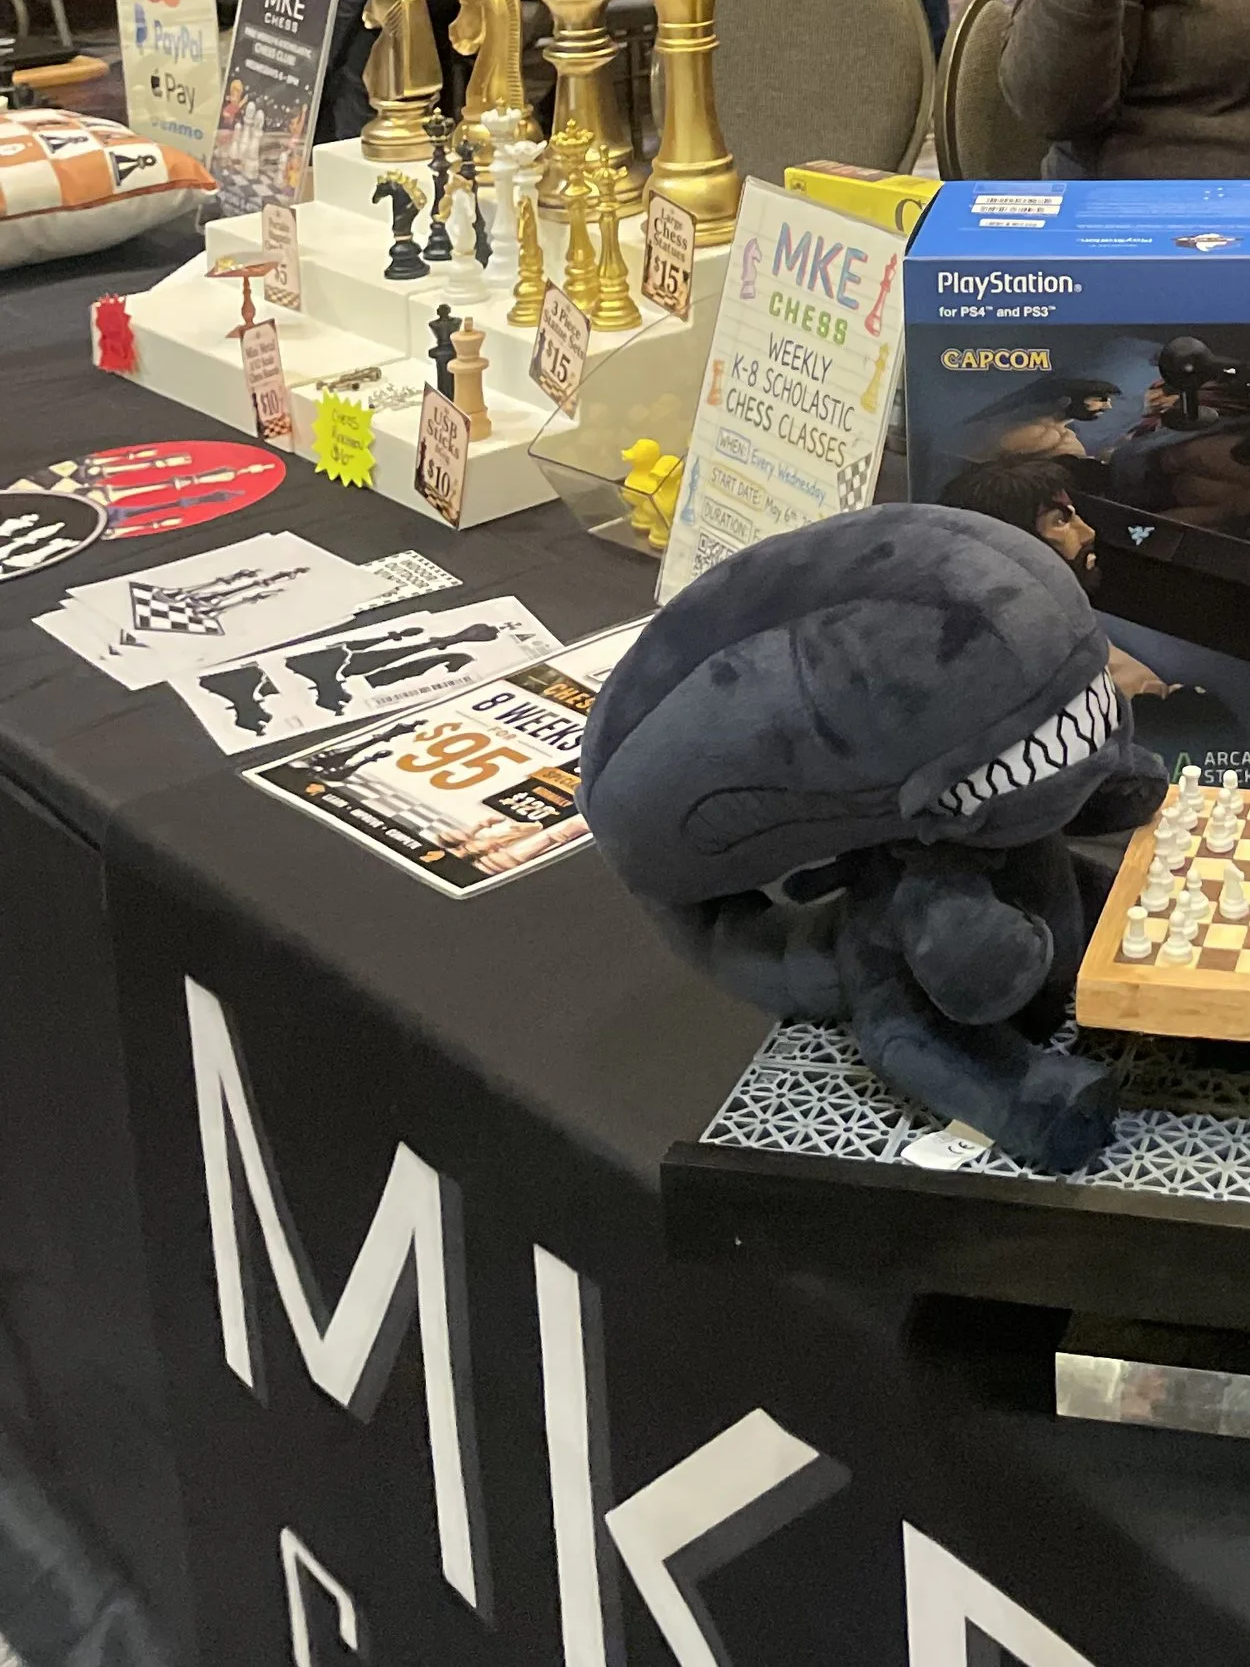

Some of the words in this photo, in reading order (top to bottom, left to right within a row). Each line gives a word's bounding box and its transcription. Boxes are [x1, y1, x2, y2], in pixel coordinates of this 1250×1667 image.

[153, 19, 203, 64] PayPal
[264, 12, 298, 34] CHESS
[165, 72, 196, 115] Pay
[654, 217, 688, 251] Chess
[661, 207, 683, 231] Large
[653, 232, 686, 264] Statues
[771, 221, 869, 311] MKE
[653, 255, 679, 295] $15
[938, 271, 1074, 300] PlayStation
[551, 301, 559, 316] 3
[560, 308, 581, 340] Piece
[769, 291, 848, 346] CHESS
[939, 306, 957, 317] for
[996, 306, 1020, 317] and
[547, 339, 571, 383] $15
[768, 332, 833, 384] WEEKLY
[941, 348, 1052, 371] CAPCOM
[260, 389, 279, 415] $10
[731, 352, 759, 388] K-8
[762, 368, 856, 432] SCHOLASTIC
[427, 418, 459, 460] Sticks
[434, 406, 458, 439] USB
[726, 387, 774, 431] CHESS
[778, 414, 847, 468] CLASSES
[428, 459, 450, 498] $10
[720, 434, 747, 456] WHEN:
[751, 448, 775, 480] Every
[778, 462, 826, 507] Wednesday
[711, 467, 735, 488] START
[737, 484, 761, 505] DATE:
[765, 497, 782, 524] May
[543, 683, 596, 712] CHES
[472, 692, 516, 712] 8
[494, 701, 584, 752] WEEKS
[488, 726, 517, 742] FOR
[395, 720, 533, 791] $95
[185, 976, 1096, 1667] MK
